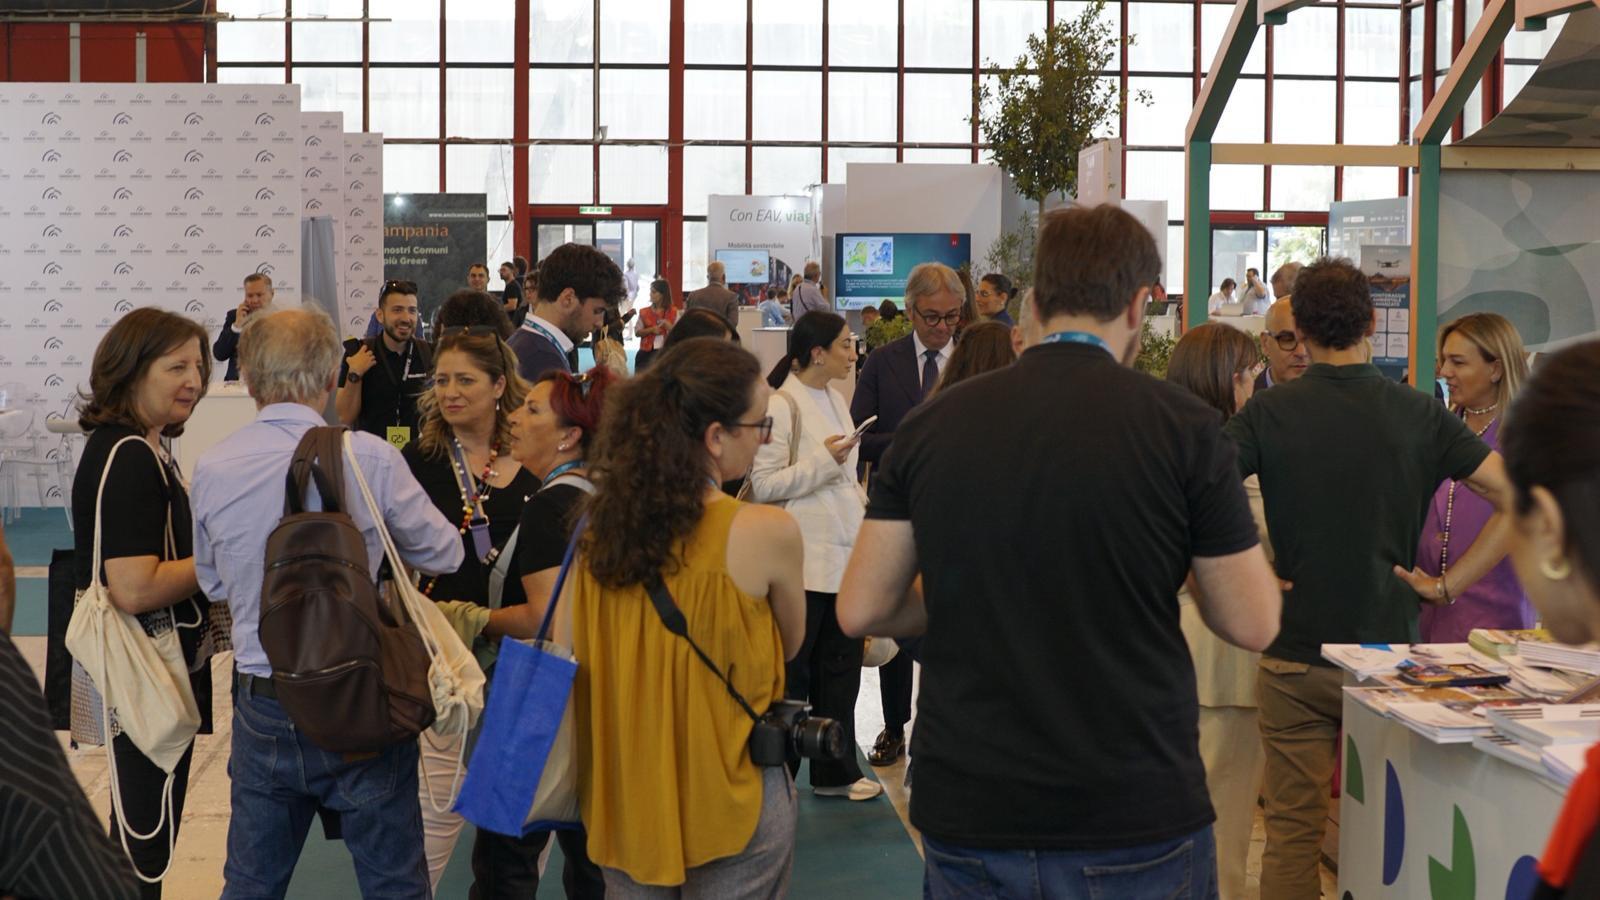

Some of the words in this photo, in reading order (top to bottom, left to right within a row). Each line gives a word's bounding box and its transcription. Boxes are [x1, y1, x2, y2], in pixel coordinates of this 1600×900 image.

[729, 208, 753, 222] Con
[755, 208, 782, 224] EAV,
[384, 246, 410, 254] nostri
[413, 246, 448, 254] Comuni
[400, 257, 428, 265] Green
